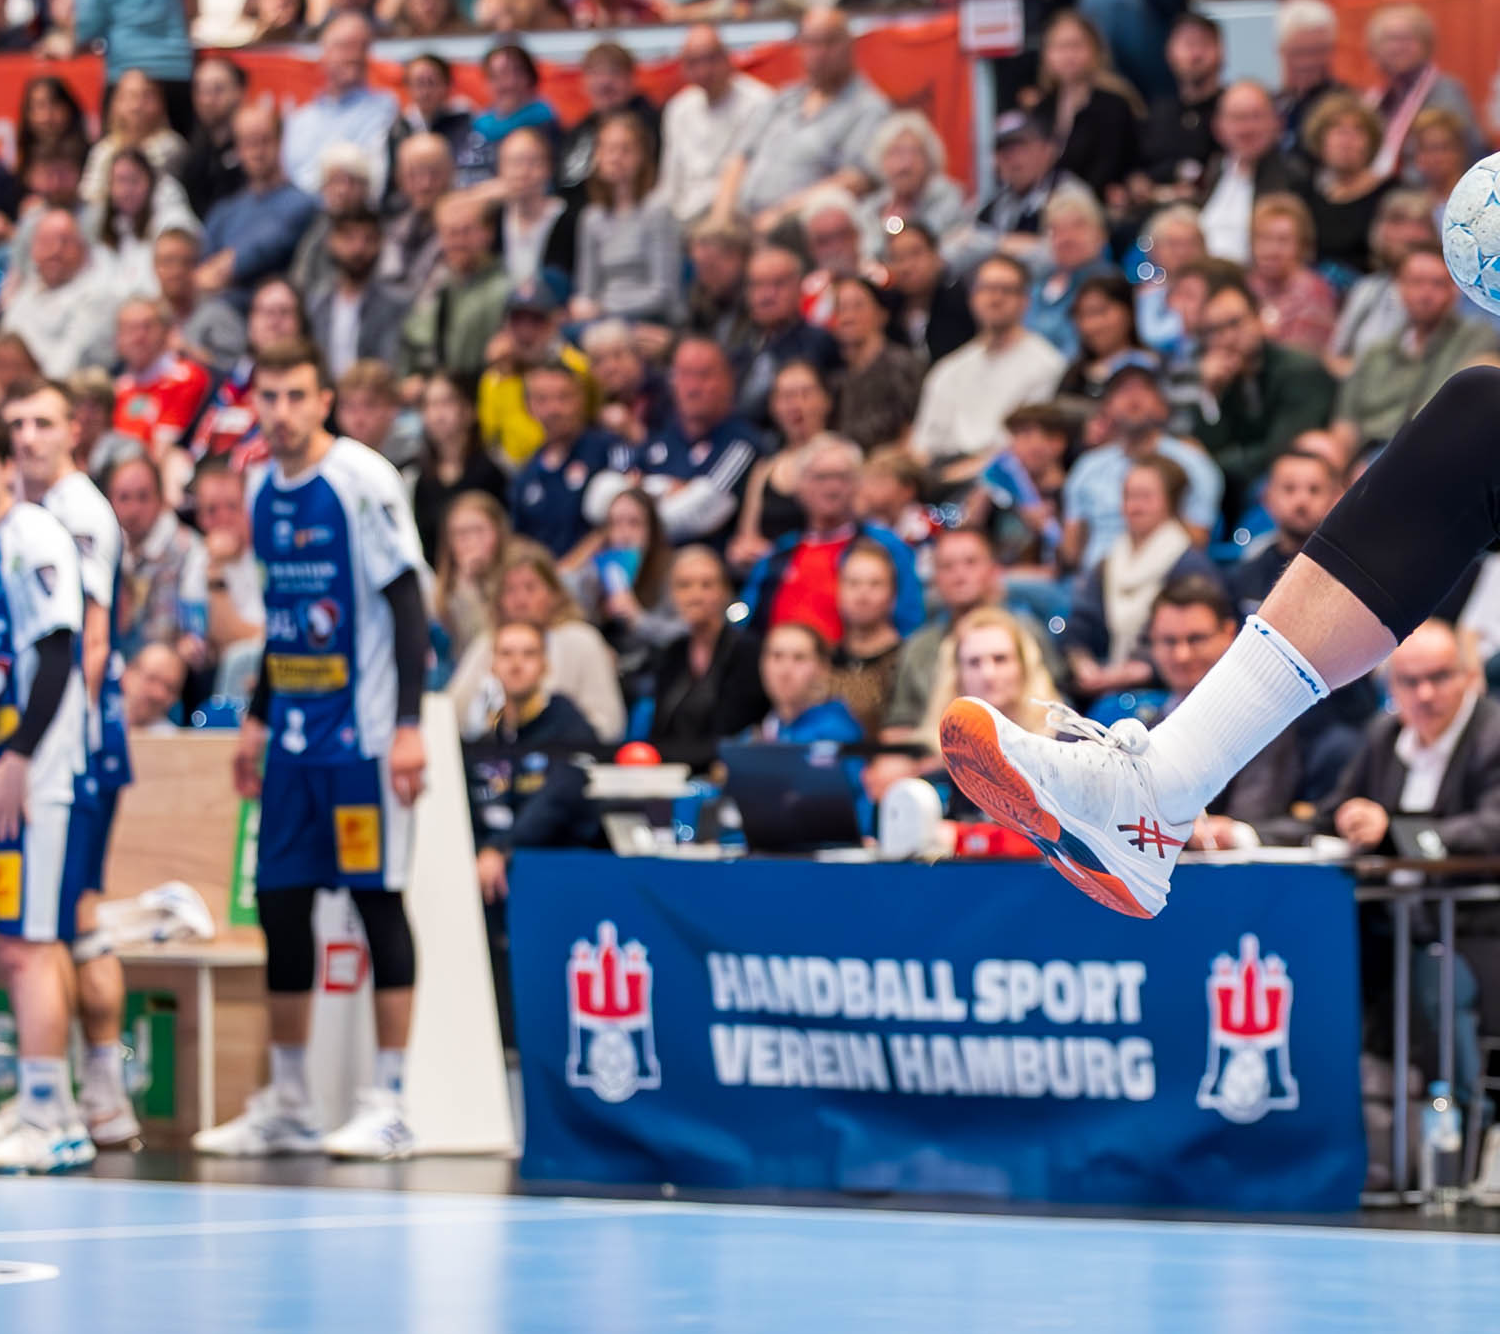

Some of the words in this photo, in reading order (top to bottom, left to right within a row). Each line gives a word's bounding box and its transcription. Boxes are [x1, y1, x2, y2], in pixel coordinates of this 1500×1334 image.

[707, 951, 964, 1023] HANDBALL
[972, 959, 1147, 1026] SPORT
[708, 1025, 889, 1093] VEREIN
[897, 1034, 1157, 1101] HAMBURG
